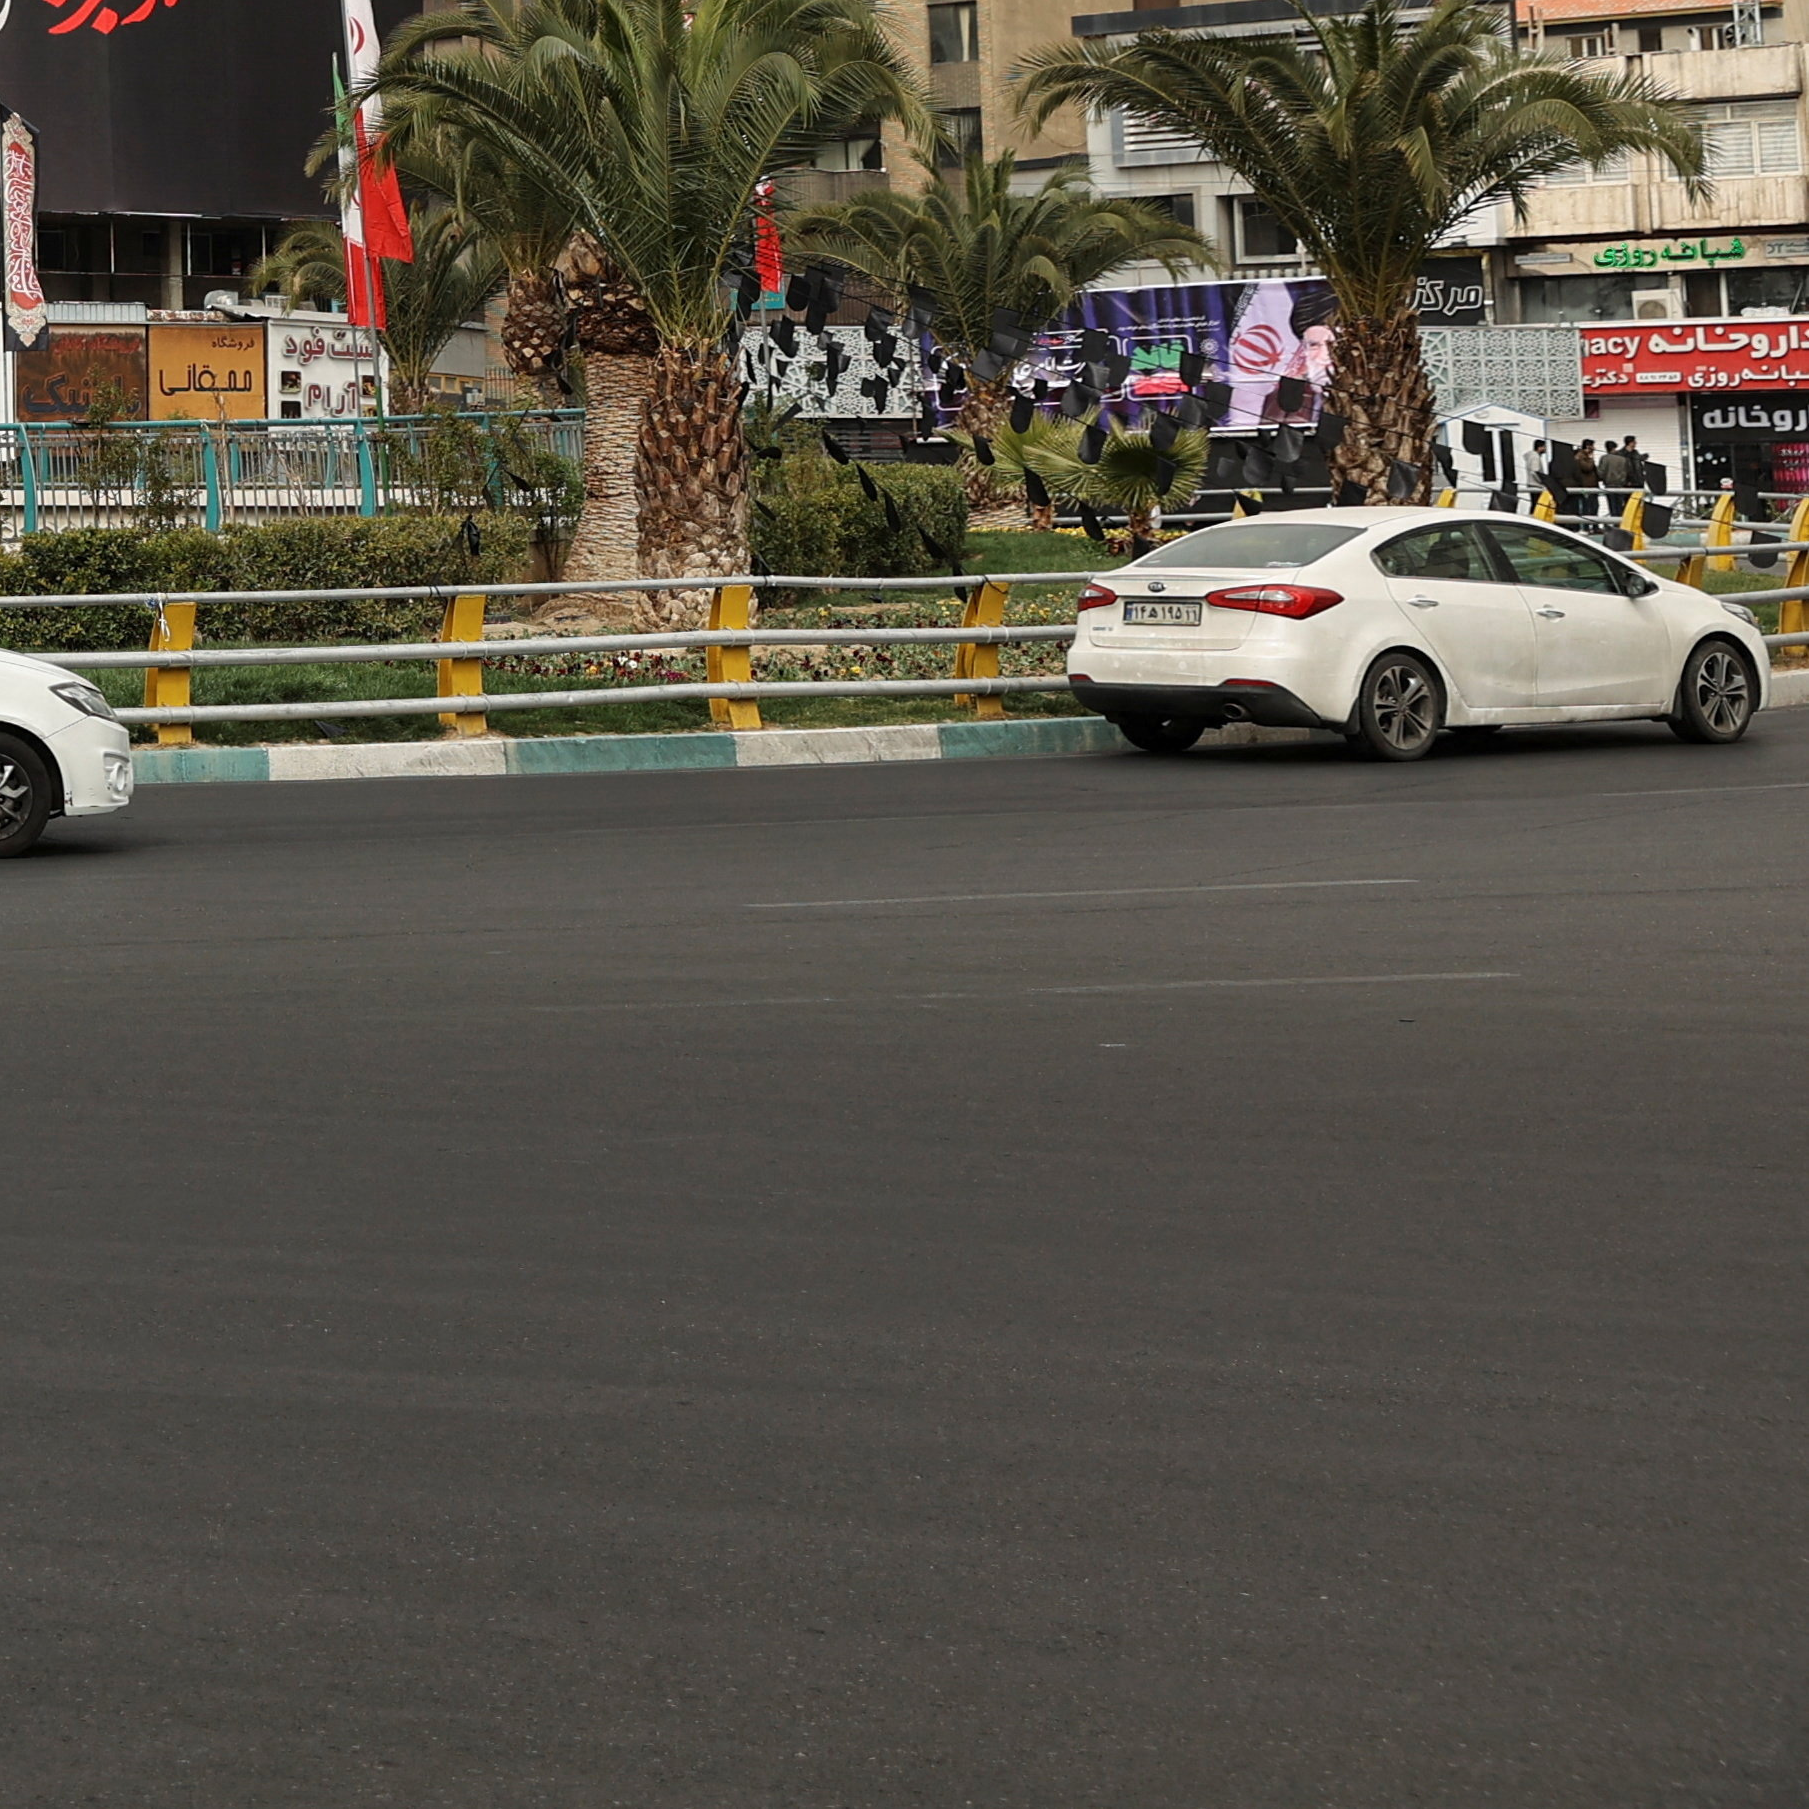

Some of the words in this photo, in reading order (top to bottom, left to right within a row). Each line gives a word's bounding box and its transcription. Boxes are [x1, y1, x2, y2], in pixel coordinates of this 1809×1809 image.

[1593, 242, 1658, 268] روزی
[1408, 276, 1483, 316] مرکز
[212, 336, 255, 351] فروشگاه
[283, 327, 326, 365] فود
[159, 363, 253, 397] ممقانی
[306, 382, 358, 416] آرام
